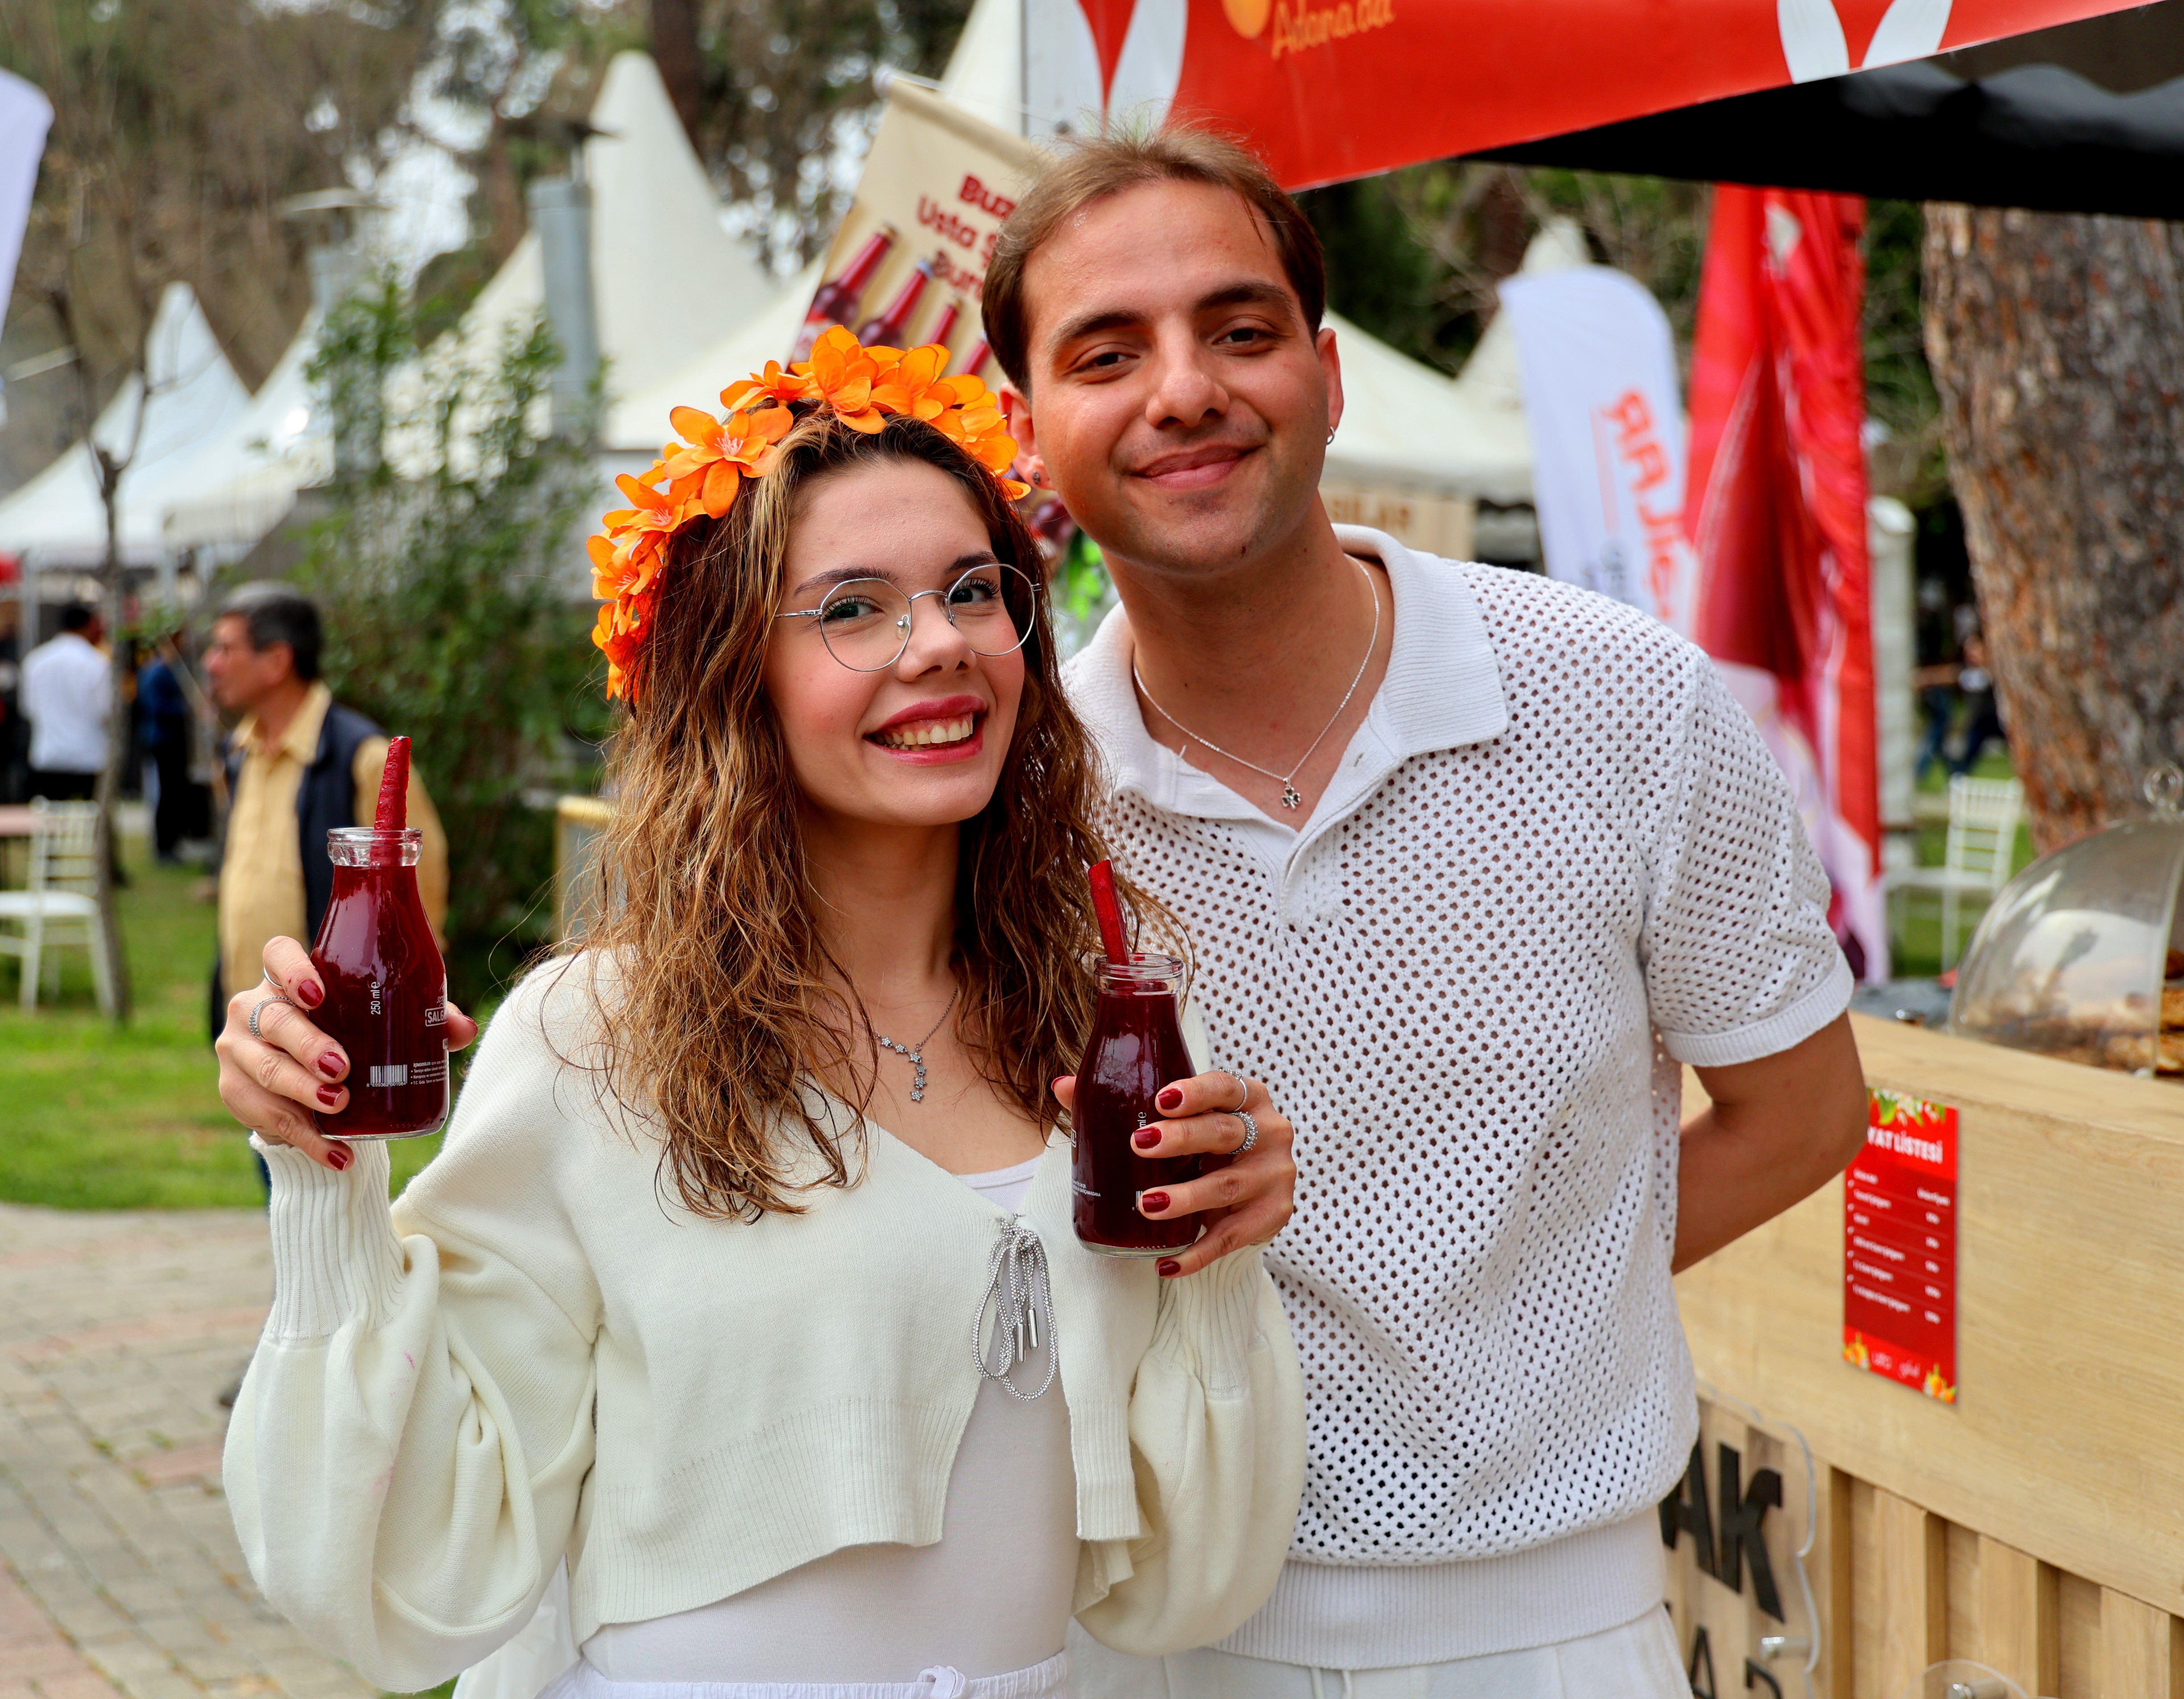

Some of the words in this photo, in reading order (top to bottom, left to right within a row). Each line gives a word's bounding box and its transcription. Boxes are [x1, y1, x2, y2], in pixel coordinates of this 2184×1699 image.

[918, 195, 977, 249] Usta
[370, 990, 380, 999] ml
[371, 1001, 381, 1015] 250
[1894, 1130, 1943, 1164] LİSTESİ
